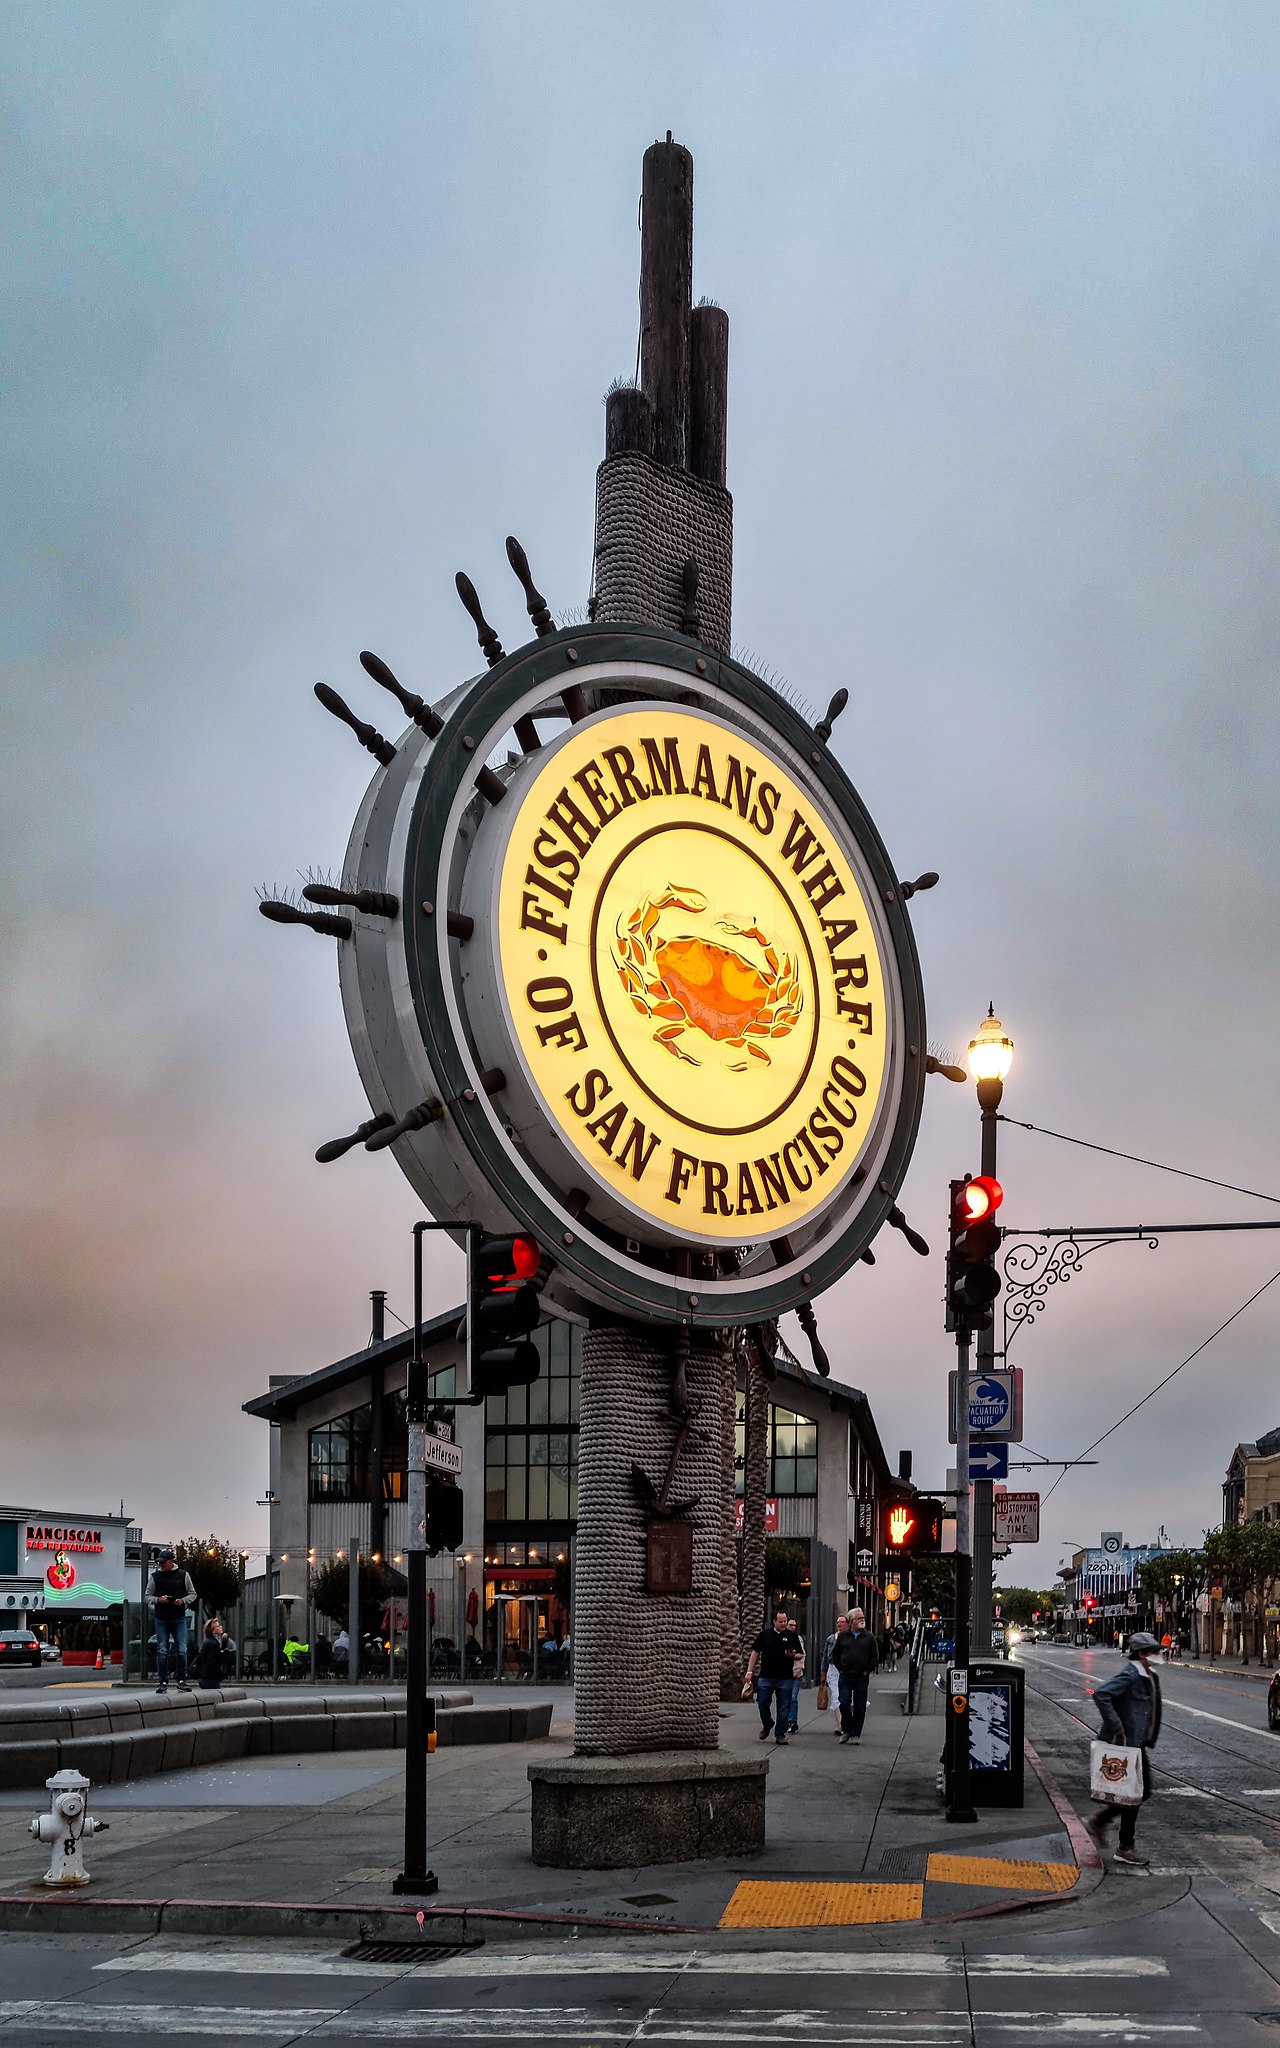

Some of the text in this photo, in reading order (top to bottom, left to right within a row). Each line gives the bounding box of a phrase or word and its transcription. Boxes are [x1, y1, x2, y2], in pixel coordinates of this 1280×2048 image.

[520, 736, 873, 1036] FISHERMANS WHARF
[528, 976, 868, 1217] OF SAN FRANCISCO
[969, 1406, 1004, 1416] ACUATION
[972, 1416, 994, 1425] ROUTE
[426, 1441, 460, 1468] Jefferson
[738, 1503, 775, 1515] ON
[996, 1502, 1037, 1513] NO STOPPING
[1007, 1515, 1027, 1524] ANY
[26, 1526, 102, 1543] RANCISCAN
[1006, 1525, 1028, 1534] TIME
[47, 1541, 105, 1552] RESTAURANT
[63, 1838, 76, 1856] 8
